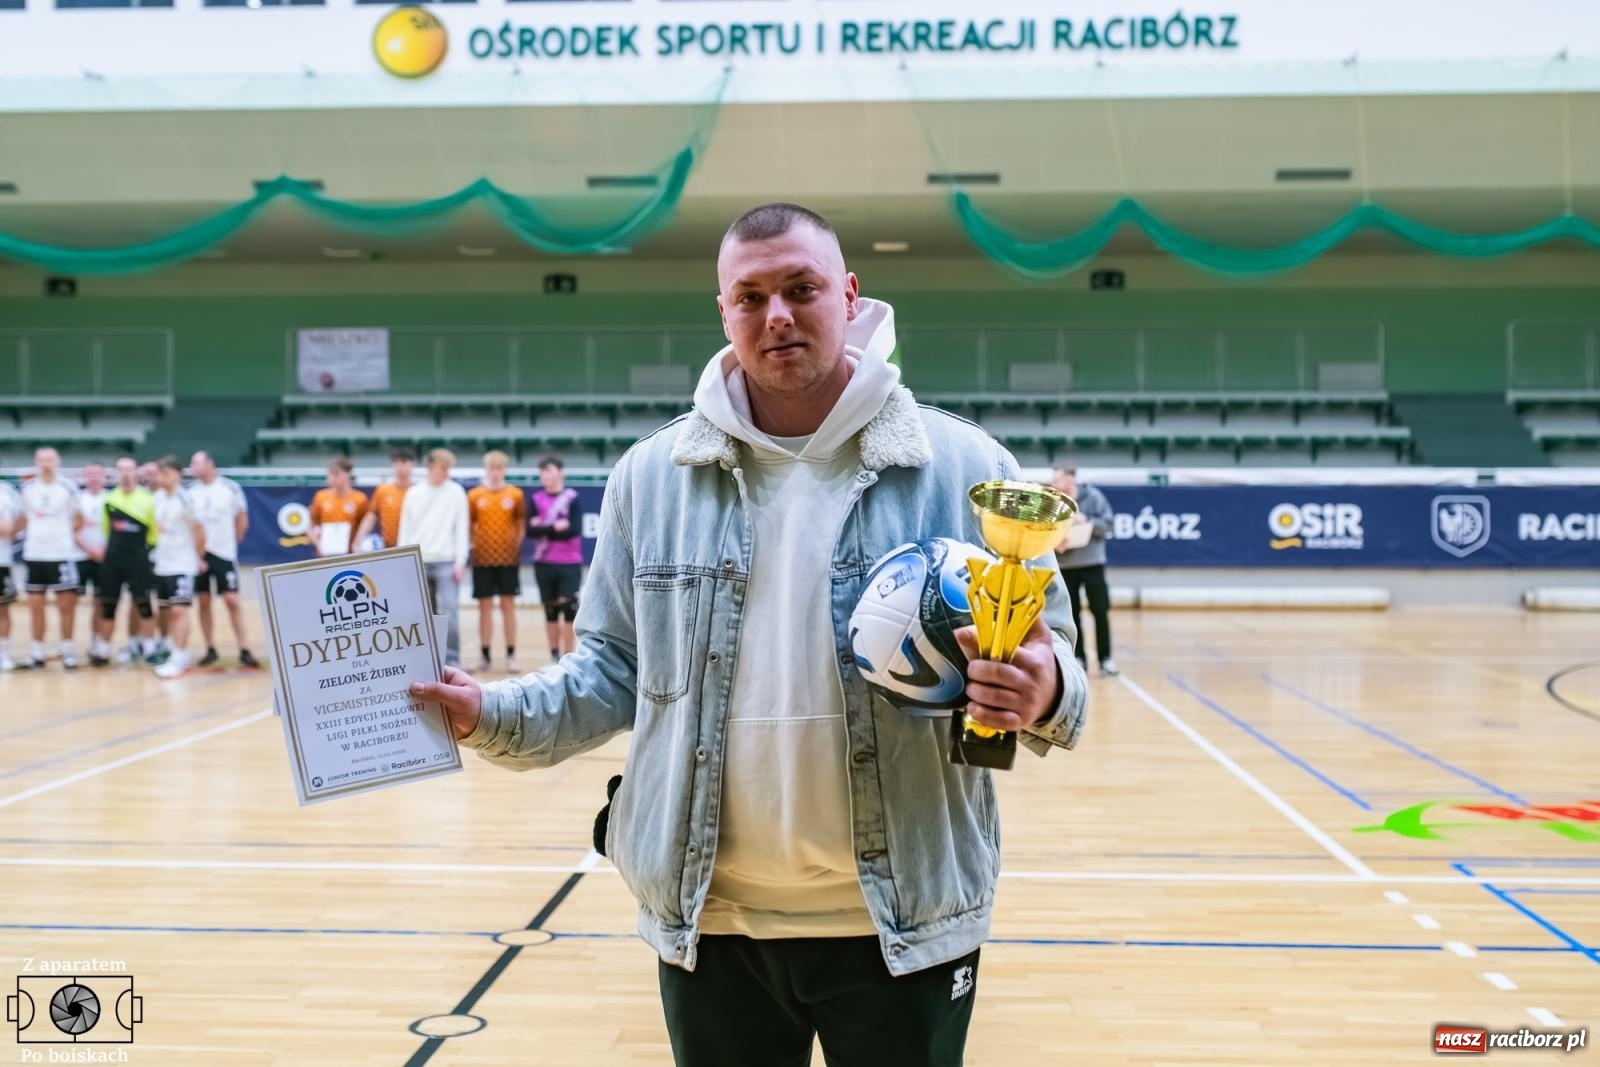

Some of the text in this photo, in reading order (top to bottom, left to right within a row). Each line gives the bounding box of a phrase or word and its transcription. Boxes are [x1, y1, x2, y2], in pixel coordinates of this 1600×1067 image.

[469, 20, 639, 58] OŚRODEK
[657, 23, 800, 56] SPORTU
[817, 23, 824, 53] I
[841, 19, 1035, 52] REKREACJI
[1054, 10, 1239, 49] RACIBÓRZ
[1518, 512, 1600, 540] RACI
[319, 598, 389, 624] HLPN
[325, 616, 388, 633] RACIBÓRZ
[289, 622, 424, 668] DYPLOM
[319, 664, 406, 689] ZIELONE ŻUBRY
[352, 660, 370, 668] DLA
[314, 689, 415, 715] VICEMISTRZOSTW
[360, 686, 372, 695] ZA
[315, 702, 425, 731] XXIII EDYCJI HALOWEJ
[326, 716, 417, 742] LIGI PIŁKI NOŻNEJ
[341, 732, 409, 752] W RACIBORZU
